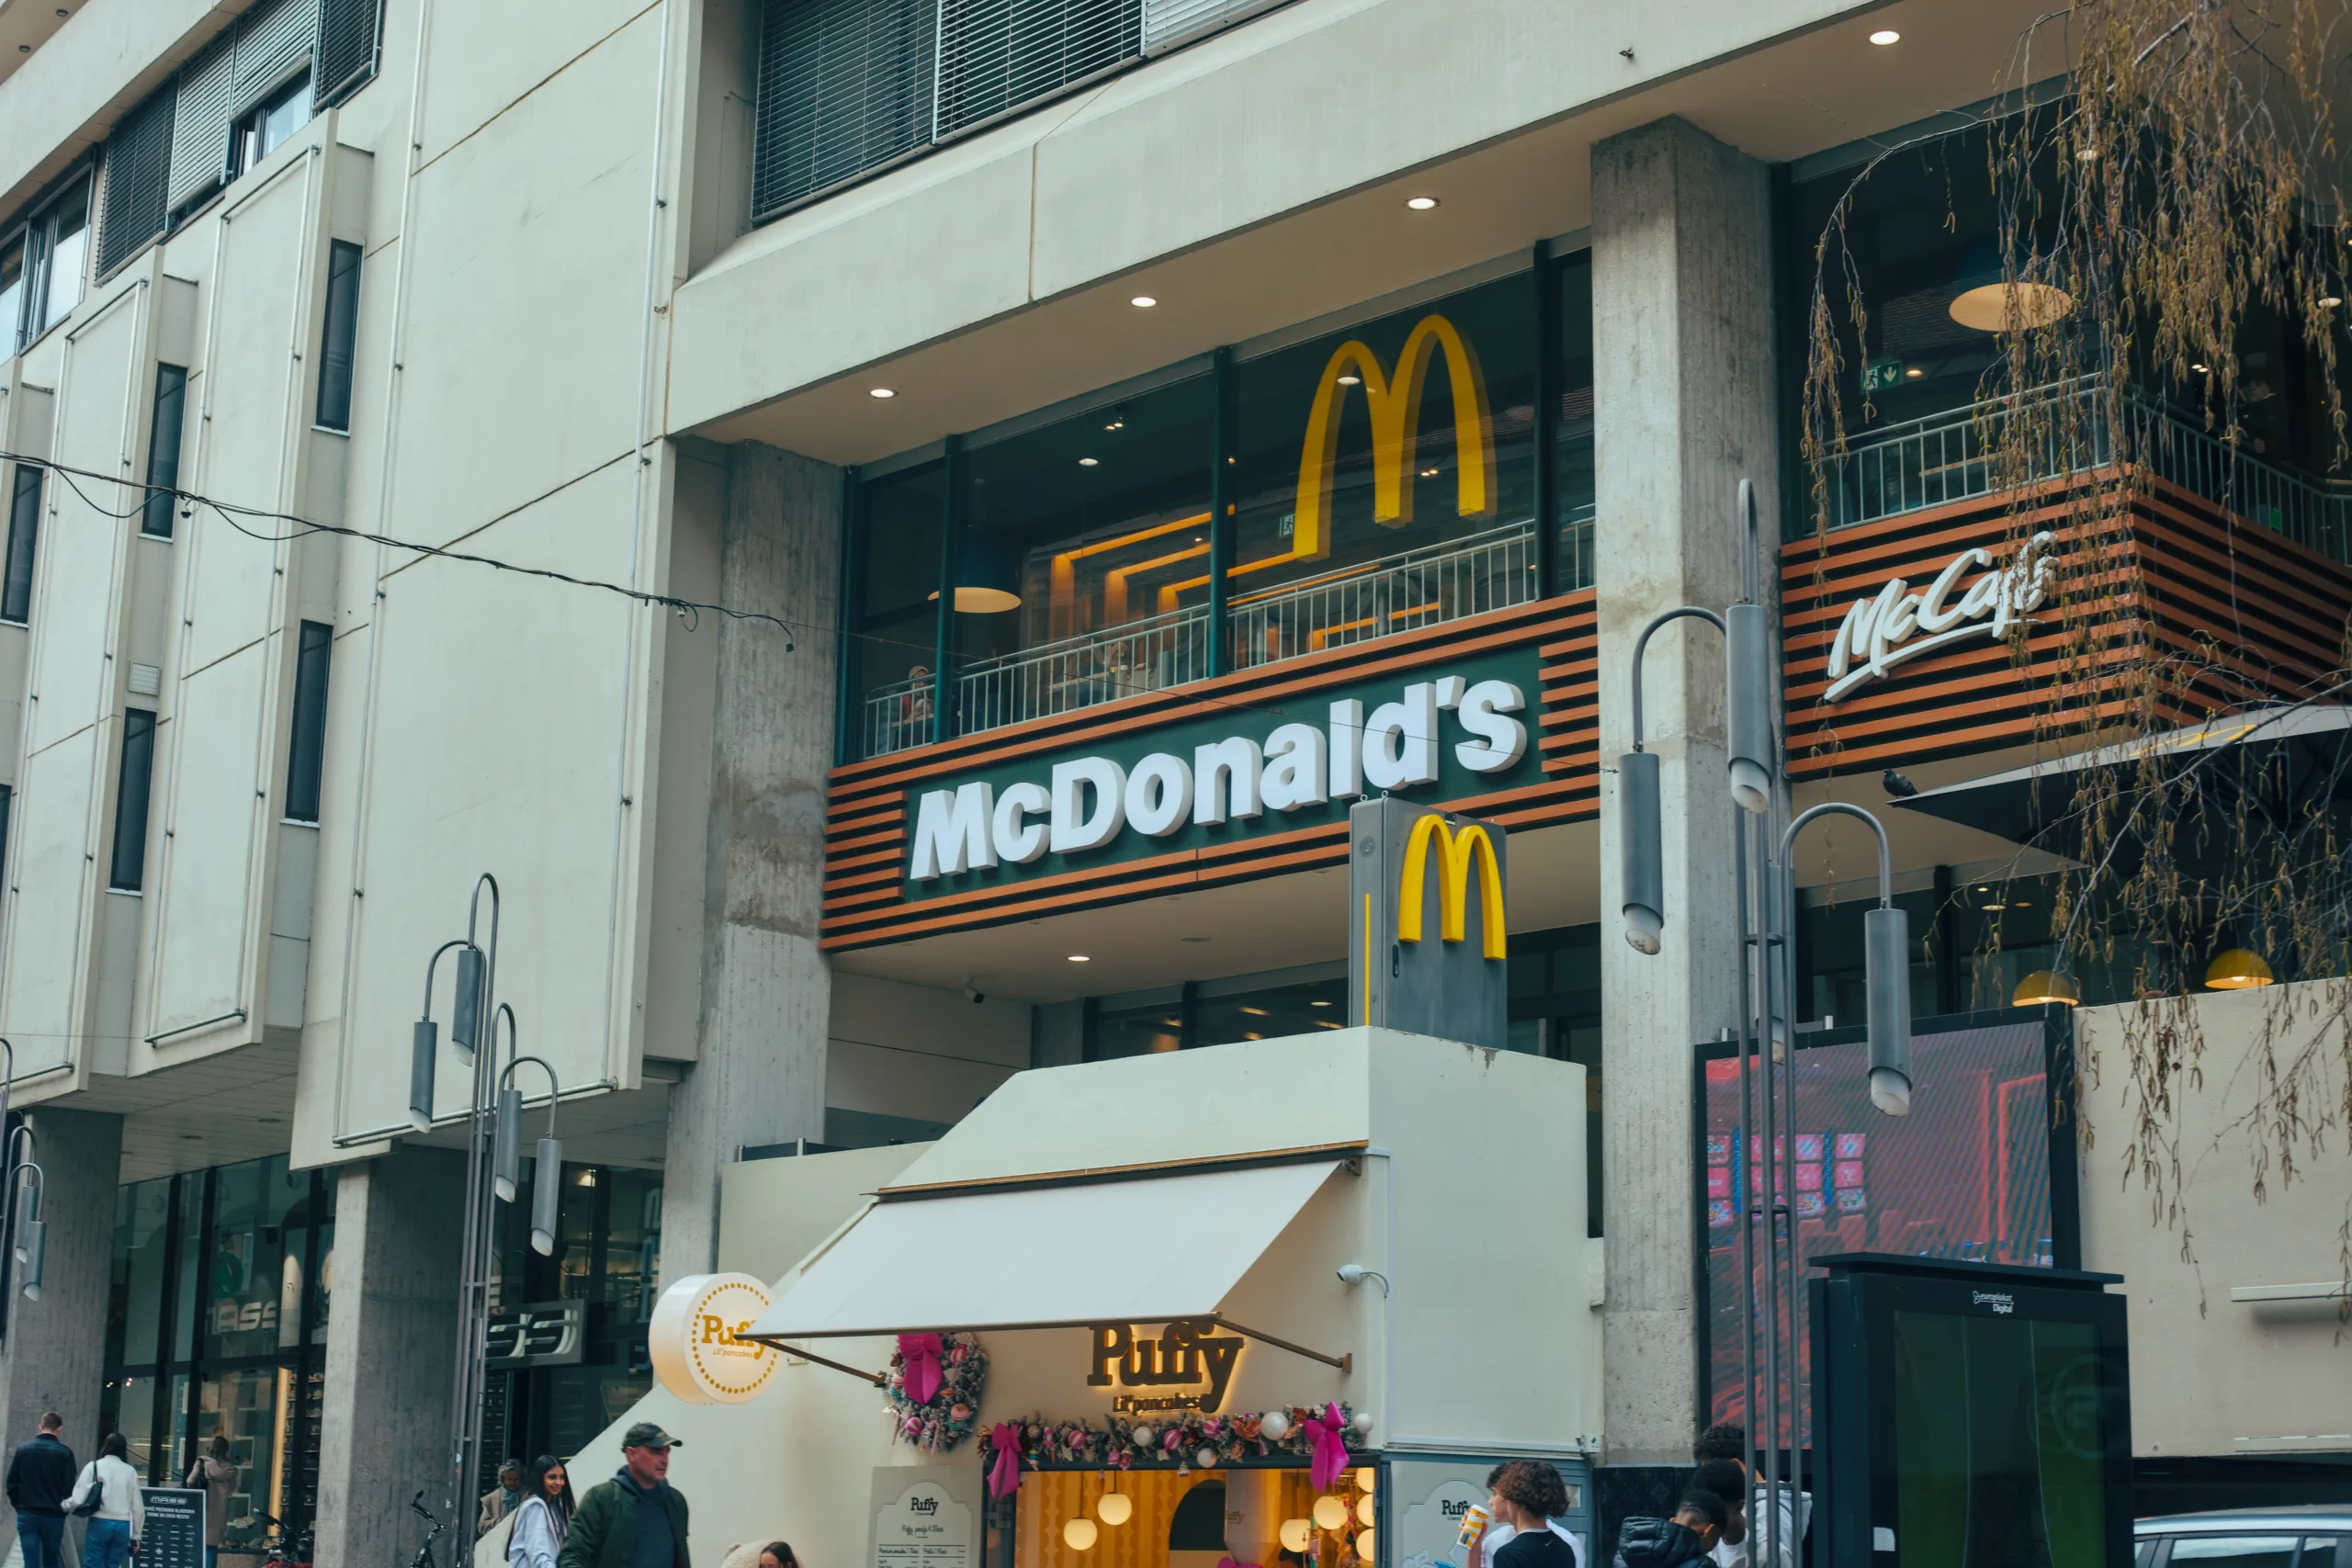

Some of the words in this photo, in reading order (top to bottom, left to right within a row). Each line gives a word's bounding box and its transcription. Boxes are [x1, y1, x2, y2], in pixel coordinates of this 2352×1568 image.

[910, 675, 1527, 881] McDonald's
[1087, 1322, 1243, 1413] Puffy
[910, 1497, 939, 1516] Puffy
